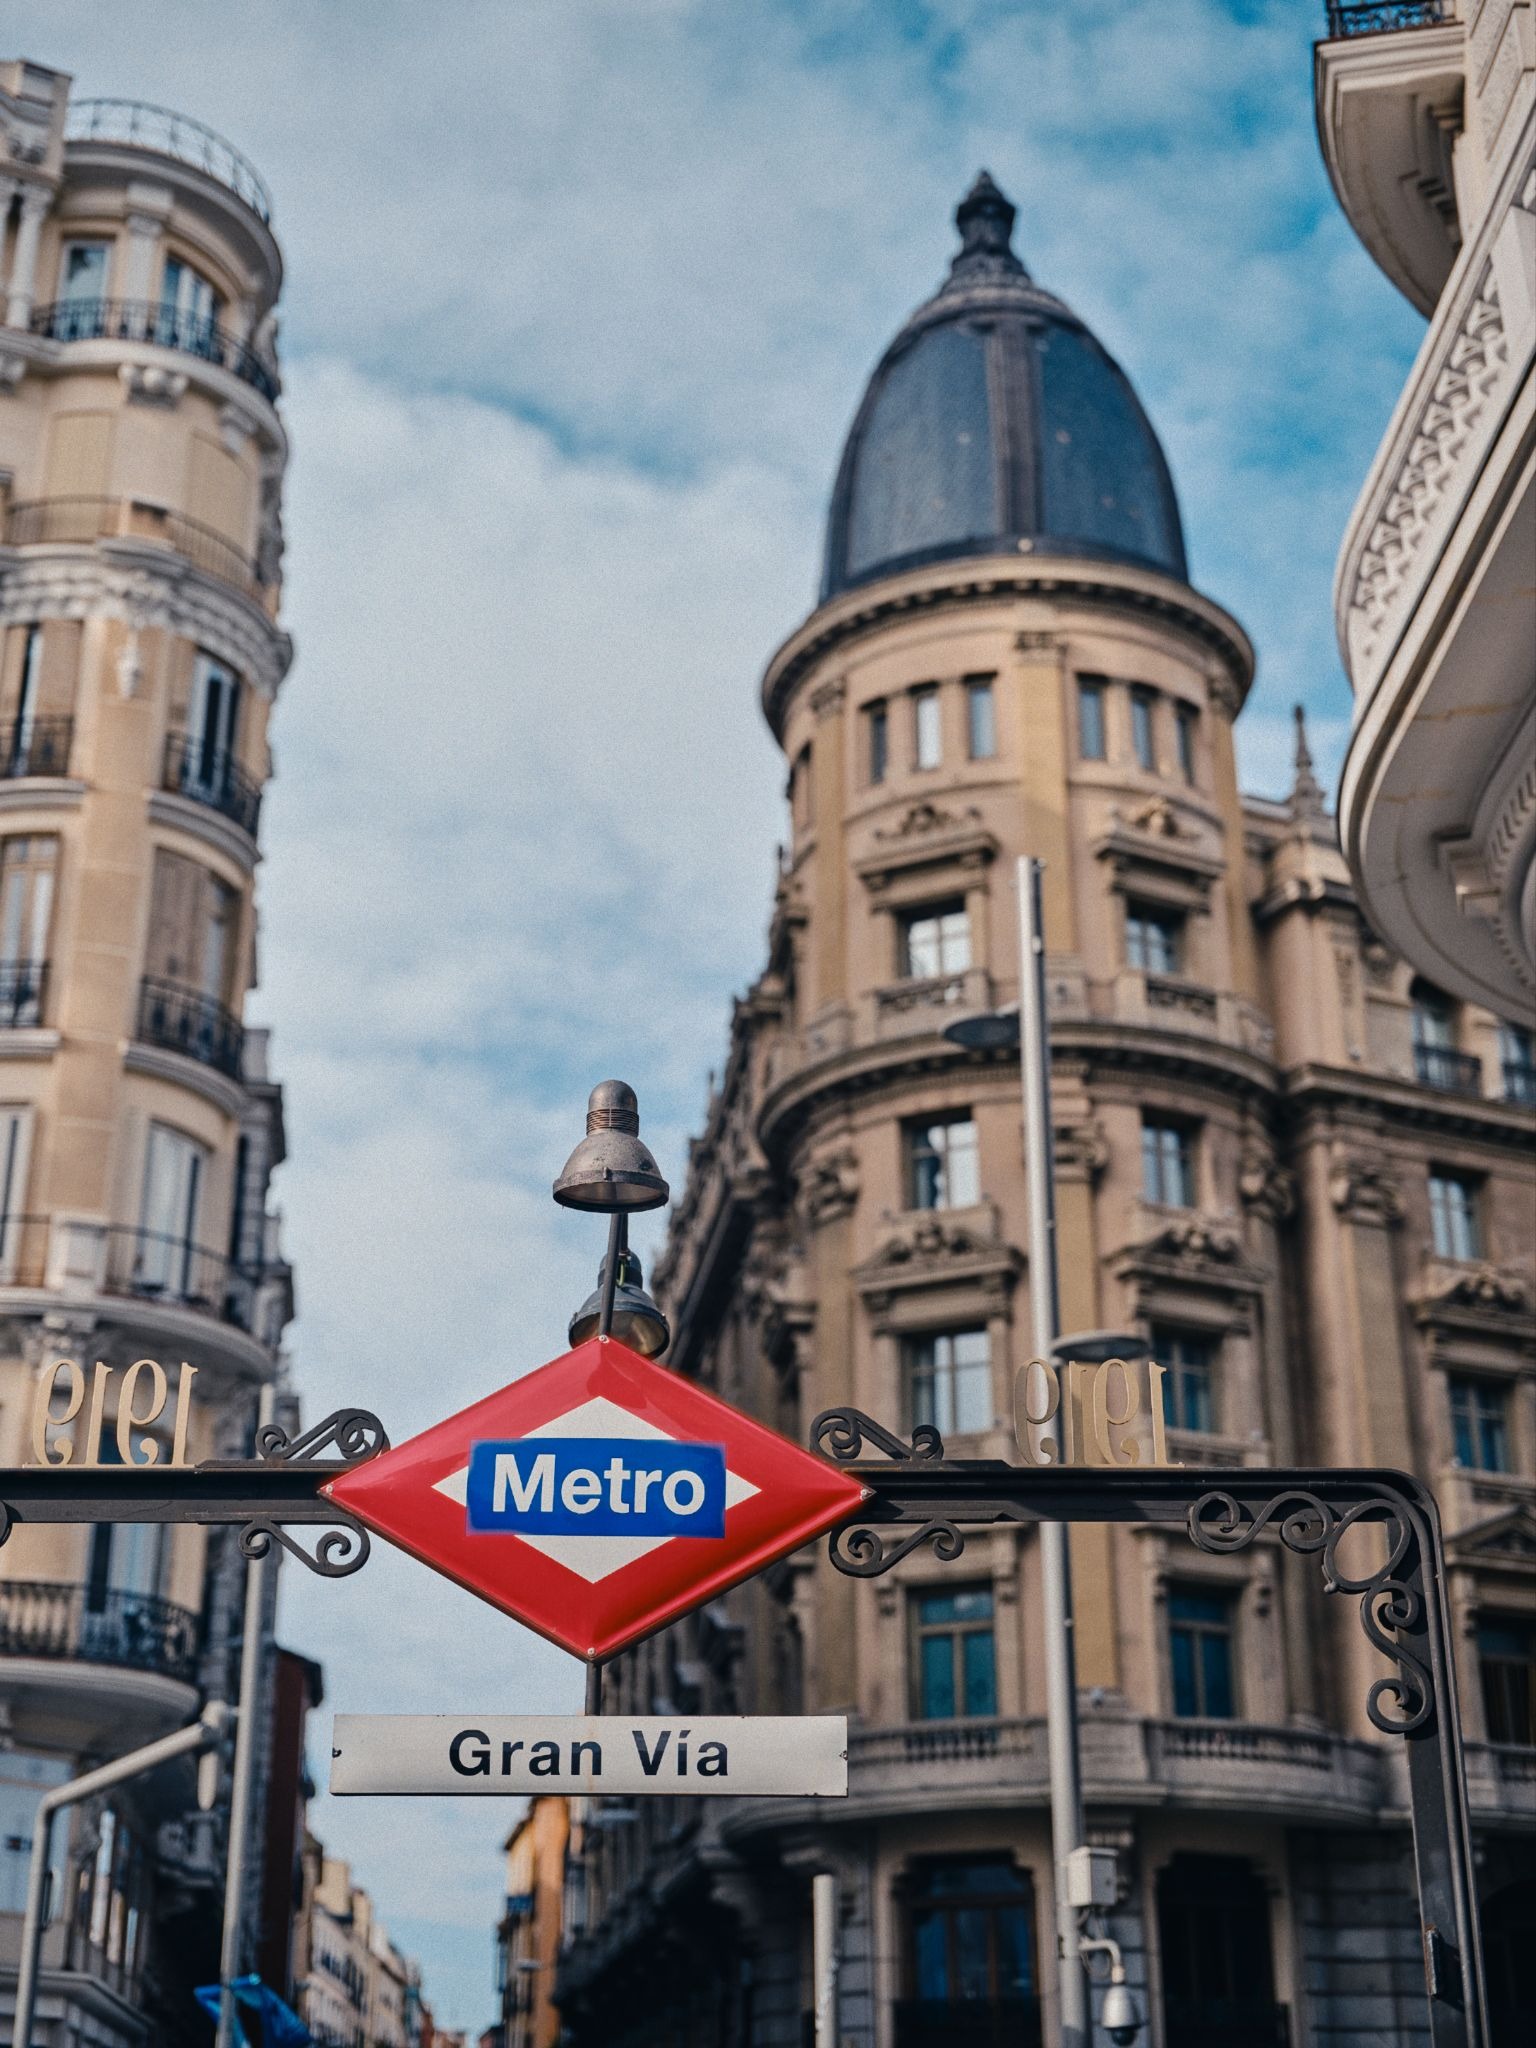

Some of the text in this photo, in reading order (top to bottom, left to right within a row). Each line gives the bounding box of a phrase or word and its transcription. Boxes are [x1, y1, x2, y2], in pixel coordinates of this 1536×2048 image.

[492, 1453, 706, 1516] Metro
[448, 1729, 729, 1777] Gran Vía
